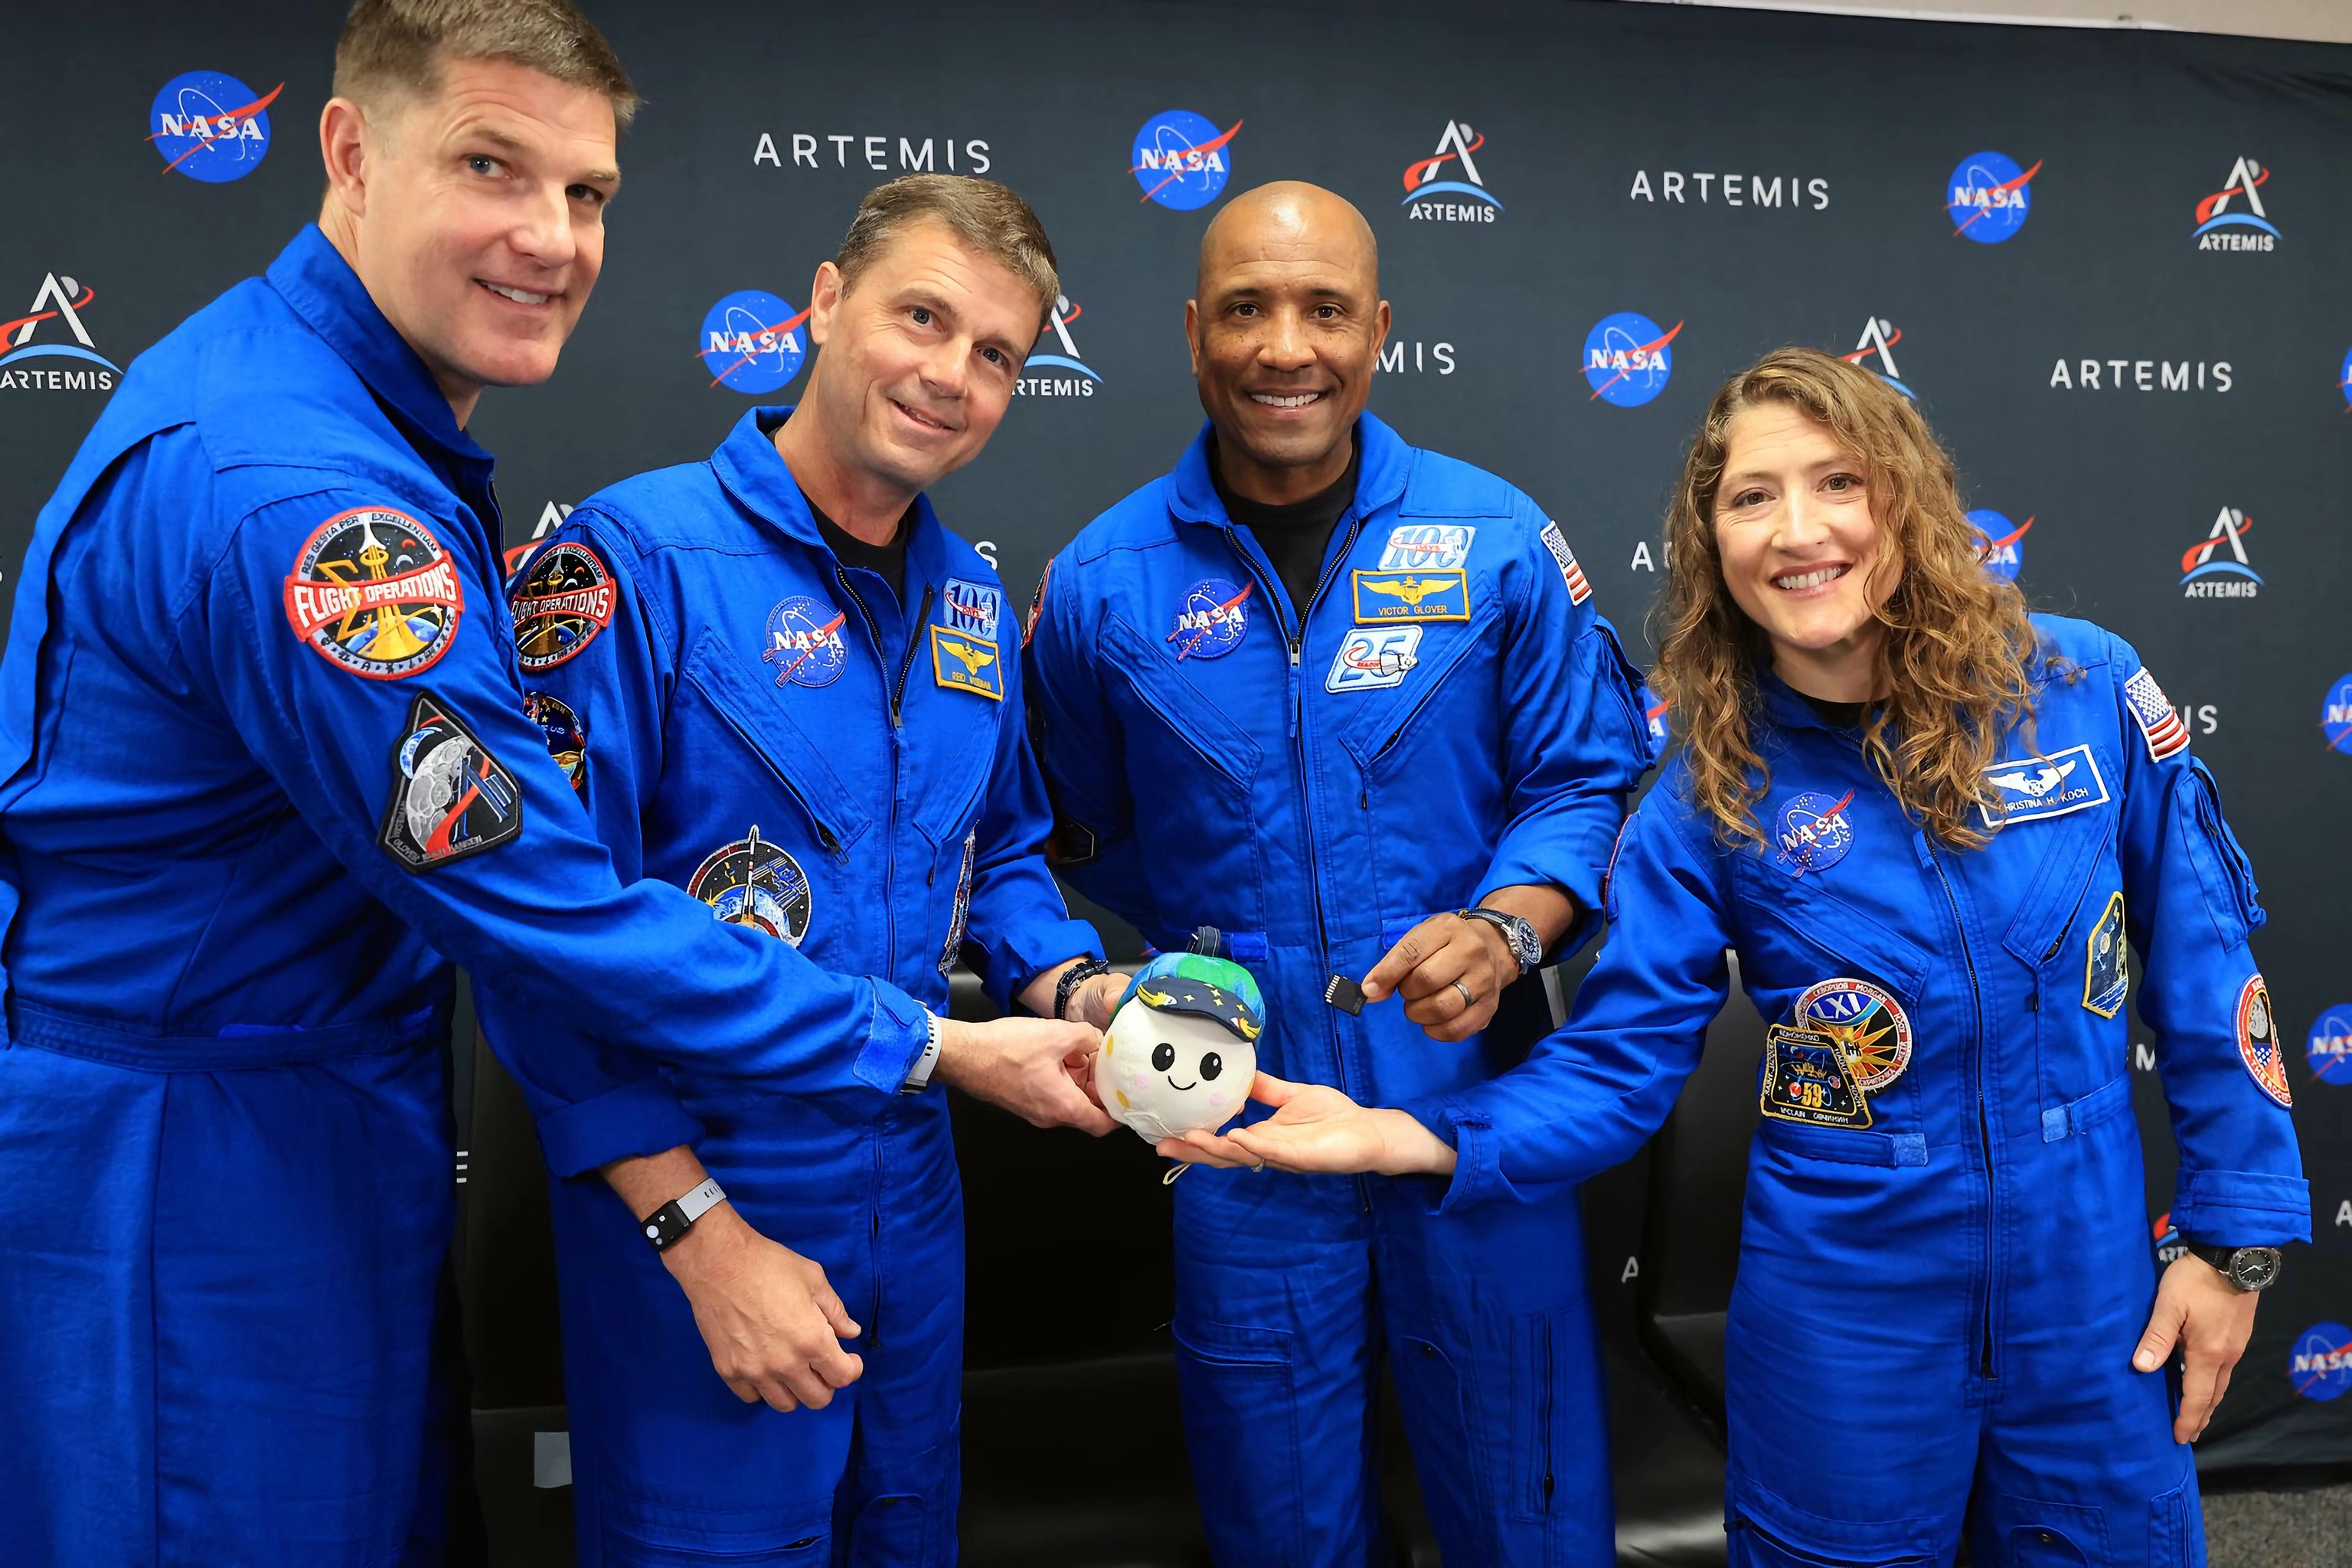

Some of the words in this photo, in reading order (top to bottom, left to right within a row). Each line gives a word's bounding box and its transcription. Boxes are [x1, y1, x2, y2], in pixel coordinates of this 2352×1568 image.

[162, 113, 265, 140] NASA
[753, 132, 991, 174] ARTEMIS
[1141, 149, 1224, 172] NASA
[1630, 170, 1829, 211] ARTEMIS
[1954, 186, 2025, 208] NASA
[1409, 202, 1495, 224] ARTEMIS
[2199, 233, 2275, 252] ARTEMIS
[710, 331, 800, 354] NASA
[1591, 348, 1668, 371] NASA
[0, 370, 113, 390] ARTEMIS
[2050, 358, 2233, 393] ARTEMIS
[1012, 378, 1093, 397] RTEMIS
[294, 584, 362, 629] FLIGHT
[364, 562, 457, 603] OPERATIONS
[2184, 580, 2257, 598] ARTEMIS
[540, 586, 610, 618] OPERATIONS
[1378, 606, 1409, 616] VICTOR
[1413, 604, 1448, 615] GLOVER
[1178, 605, 1246, 631] NASA
[773, 629, 844, 651] NASA
[2003, 798, 2043, 814] HRISTINA
[2061, 786, 2090, 803] KOCH
[1781, 812, 1850, 851] NASA
[1801, 1082, 1823, 1108] 59
